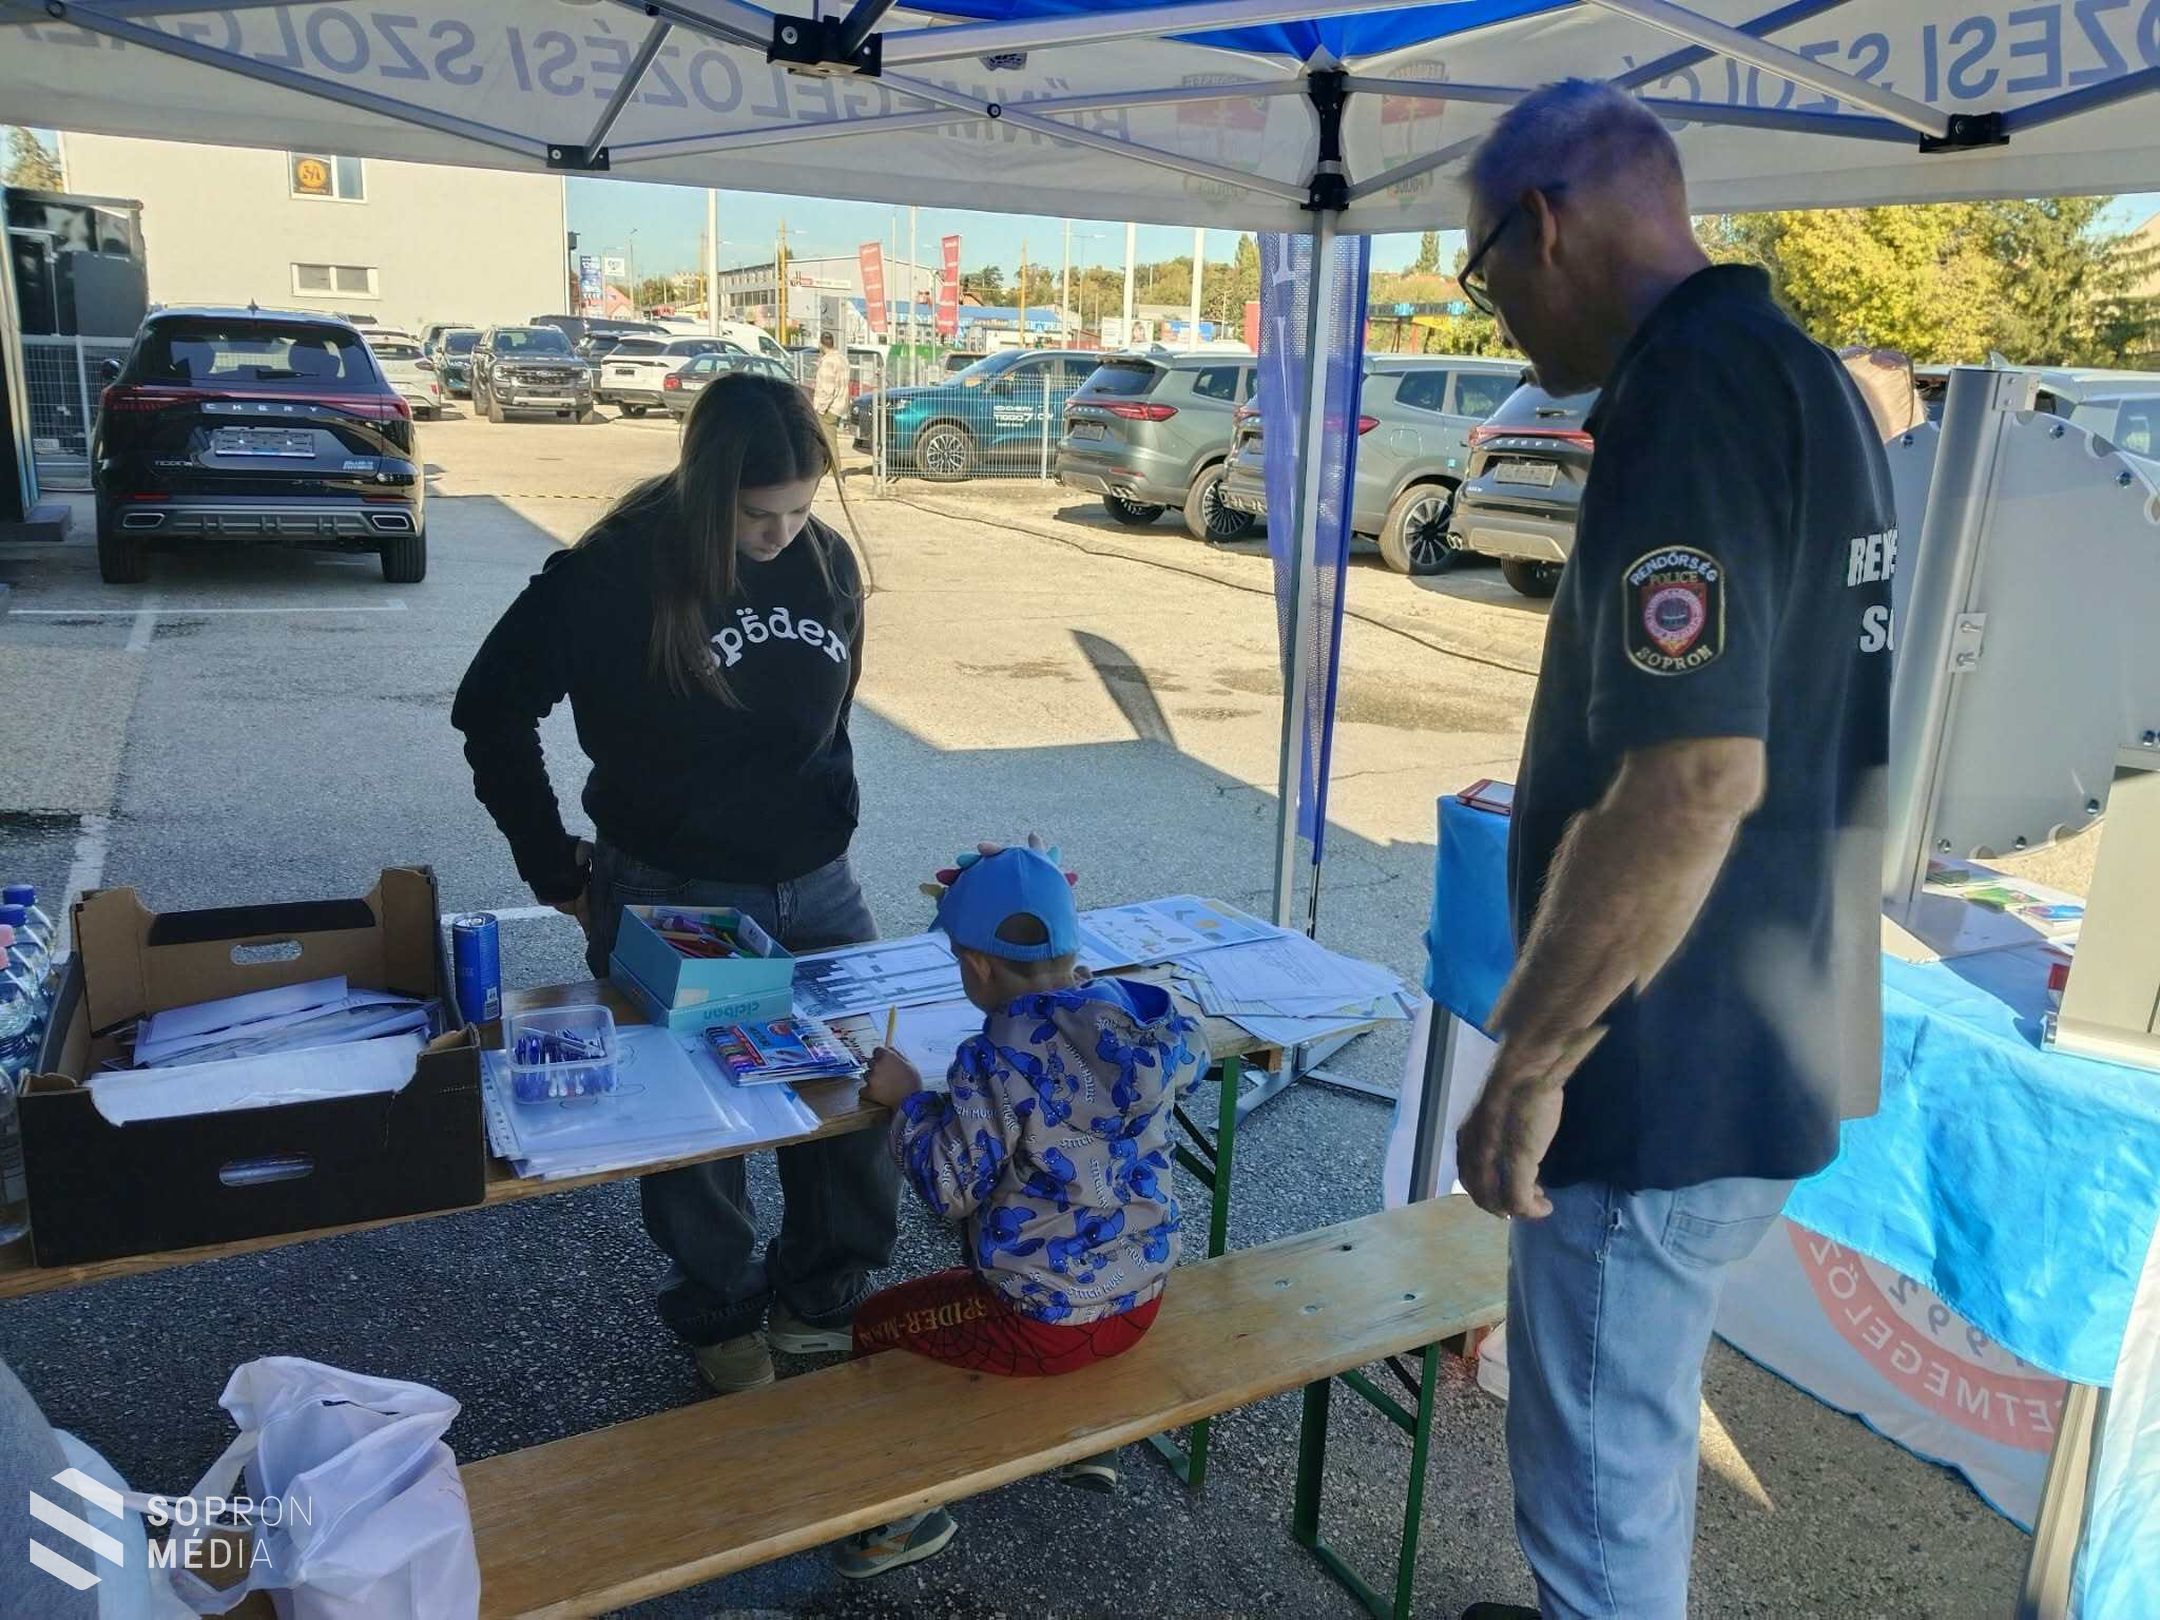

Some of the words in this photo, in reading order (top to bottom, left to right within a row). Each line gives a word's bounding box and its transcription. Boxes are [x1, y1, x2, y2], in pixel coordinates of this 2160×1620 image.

[1650, 570, 1699, 585] POLICE
[1859, 605, 1894, 652] S
[1637, 645, 1713, 670] SOPRON
